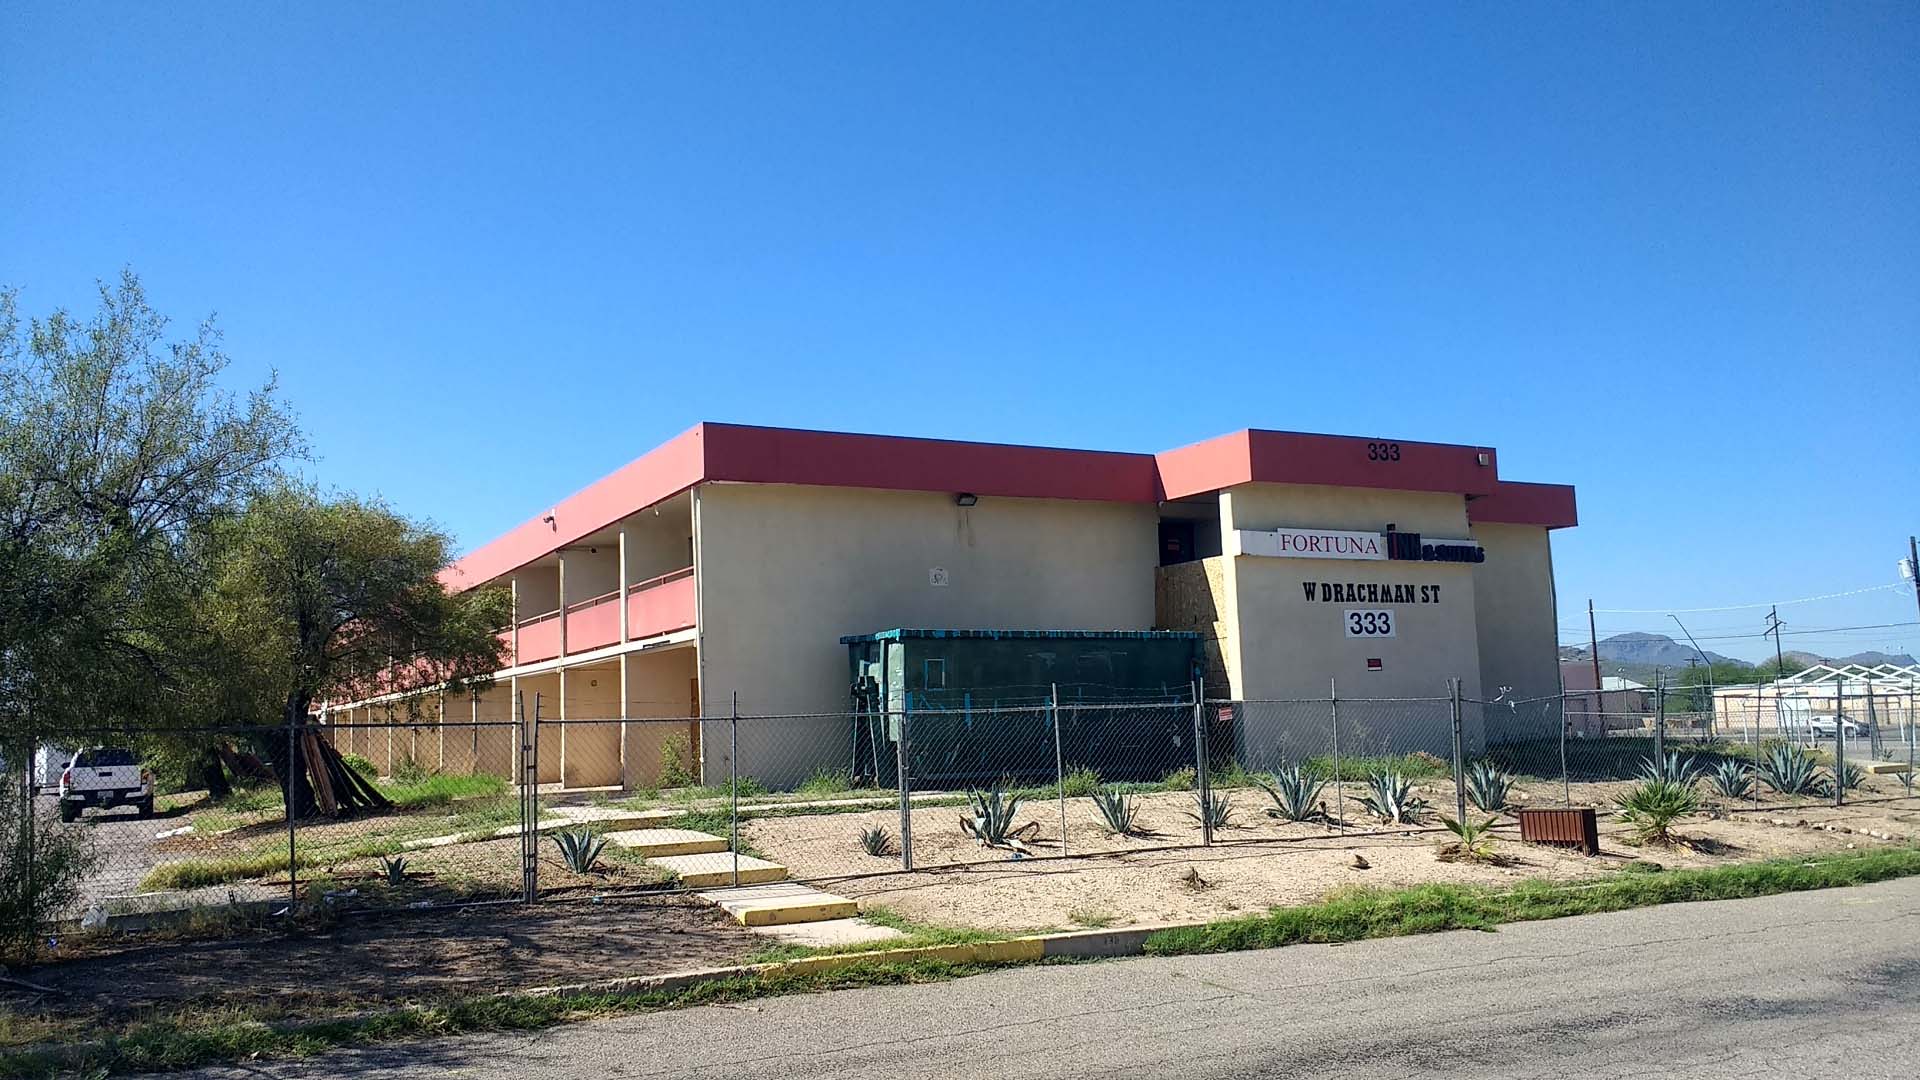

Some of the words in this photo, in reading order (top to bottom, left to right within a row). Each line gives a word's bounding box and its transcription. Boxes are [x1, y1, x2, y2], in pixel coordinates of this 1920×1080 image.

[1368, 443, 1400, 461] 333
[1281, 534, 1379, 555] FORTUNA
[1302, 582, 1317, 601] W
[1321, 583, 1415, 603] DRACHMAN
[1421, 585, 1440, 603] ST
[1349, 612, 1391, 634] 333
